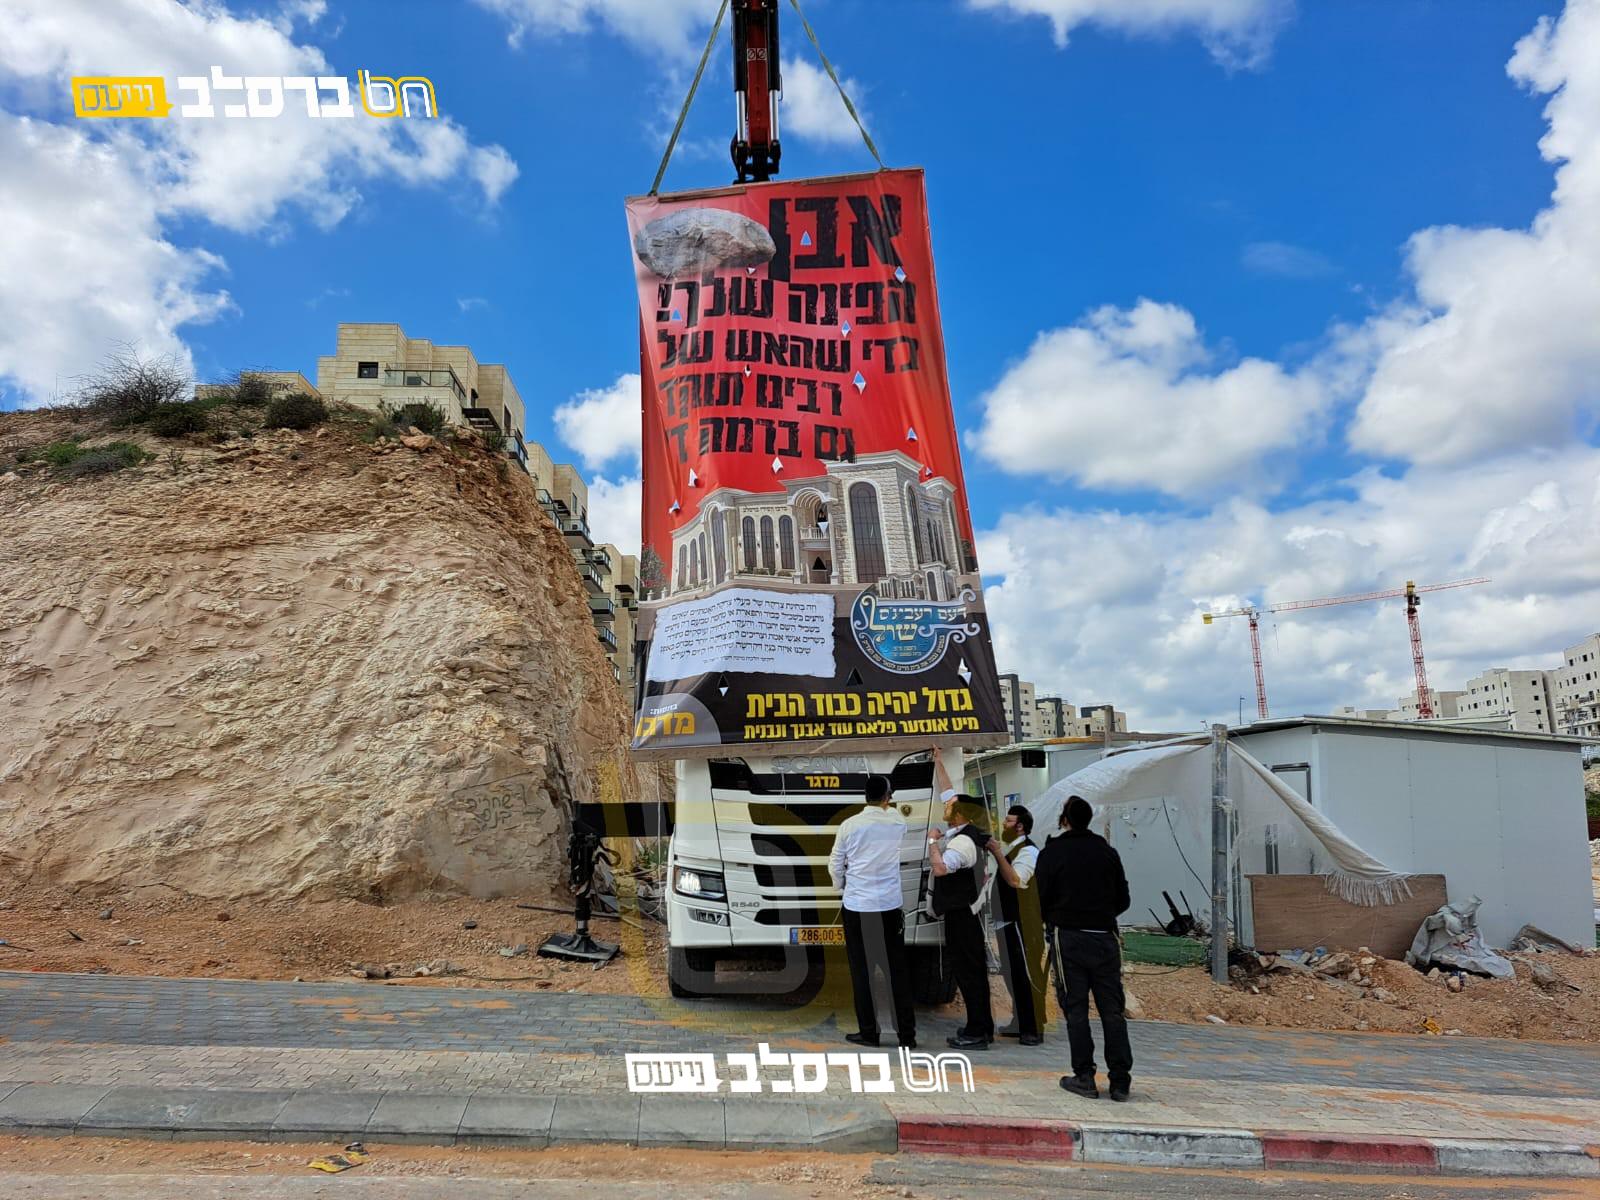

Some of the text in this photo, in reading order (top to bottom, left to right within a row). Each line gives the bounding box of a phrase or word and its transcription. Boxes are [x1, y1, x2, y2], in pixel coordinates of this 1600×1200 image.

[768, 194, 902, 282] אבן
[788, 281, 916, 325] הפינה
[656, 328, 919, 374] כדי שהאש של
[659, 372, 842, 419] רבינו תוקד
[698, 417, 802, 457] ברמה
[814, 423, 858, 464] גם
[937, 606, 967, 622] דעם
[746, 686, 974, 718] גדול יהיה כבוד הבית
[744, 716, 980, 740] מיט אונזער פלאם עוד אבנך ונבנית
[771, 755, 873, 773] SCANIA
[805, 775, 840, 788] מדגר
